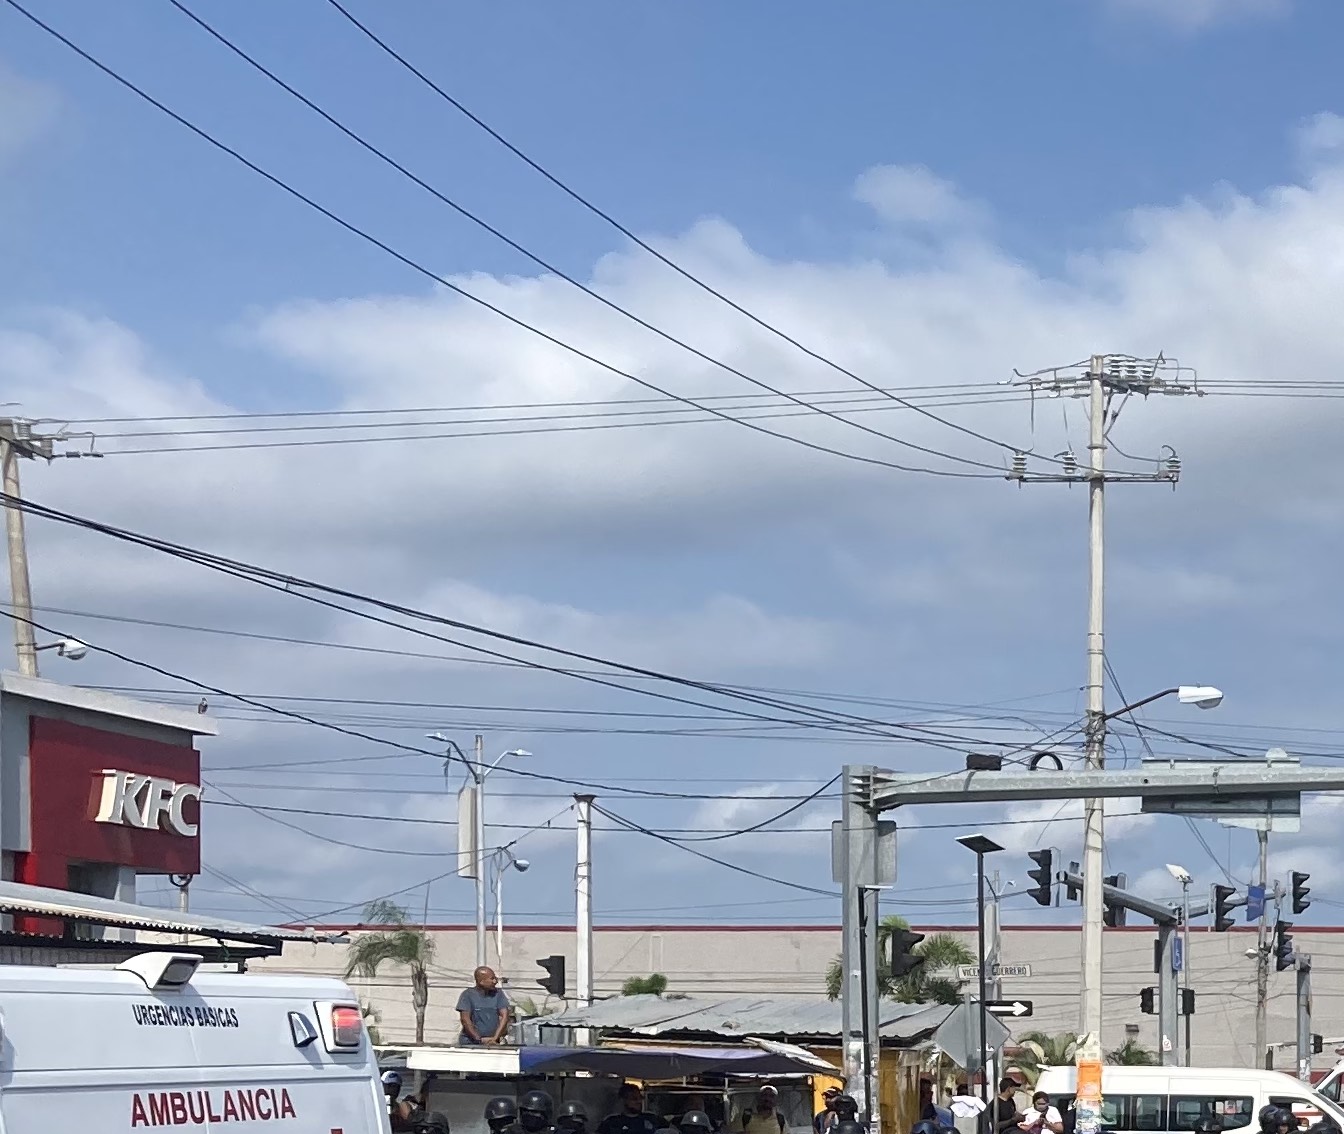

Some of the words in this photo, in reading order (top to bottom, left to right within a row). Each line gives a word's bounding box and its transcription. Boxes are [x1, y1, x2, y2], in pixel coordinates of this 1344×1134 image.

[95, 768, 202, 837] KFC
[132, 1004, 195, 1027] URGENCIAS
[197, 1006, 239, 1028] BASICAS
[131, 1087, 297, 1127] AMBULANCIA
